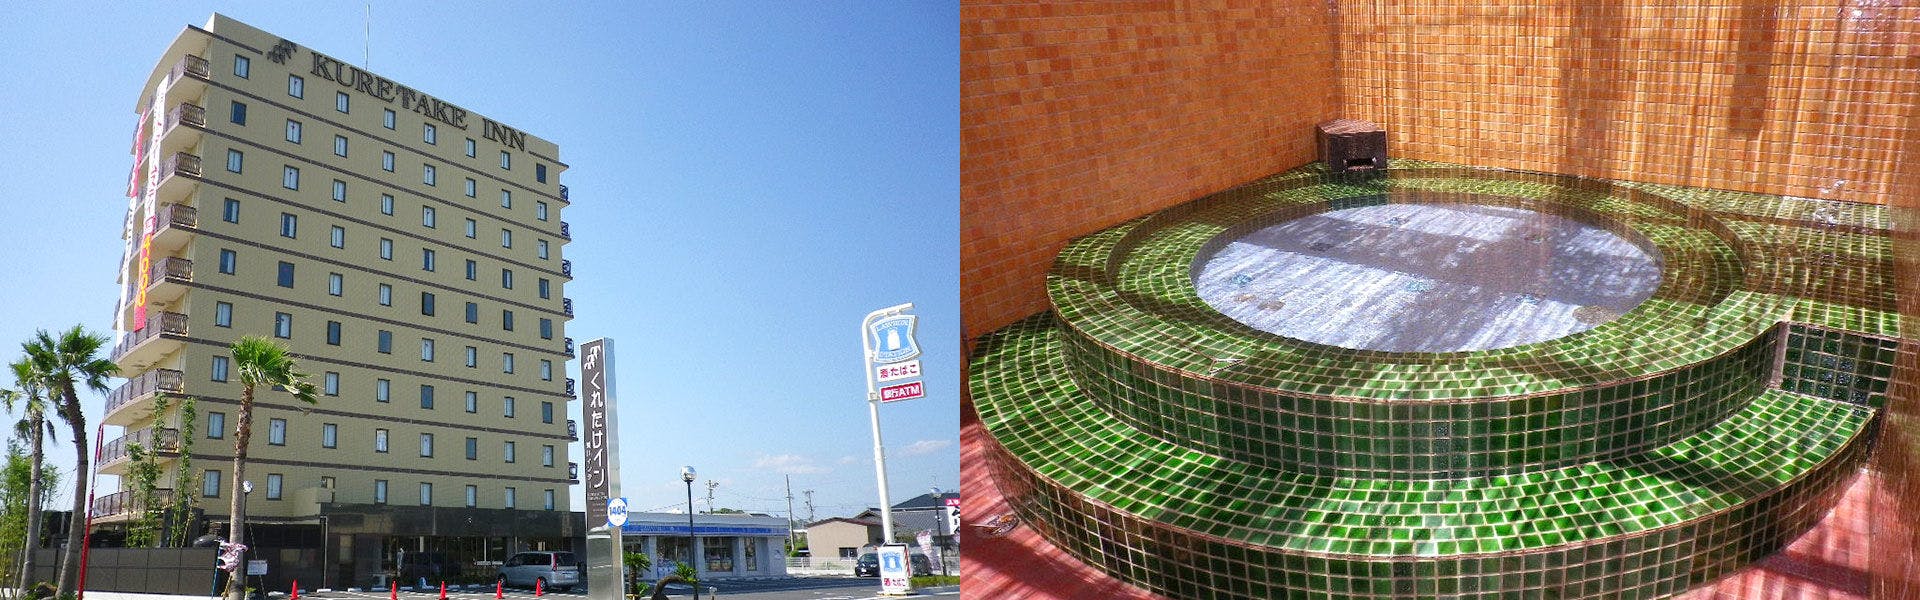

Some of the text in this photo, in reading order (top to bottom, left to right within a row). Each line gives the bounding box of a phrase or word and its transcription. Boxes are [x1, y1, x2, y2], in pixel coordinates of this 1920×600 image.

[310, 50, 527, 151] KURETAKE INN
[590, 371, 605, 488] くれたけイン
[609, 505, 627, 515] 1404
